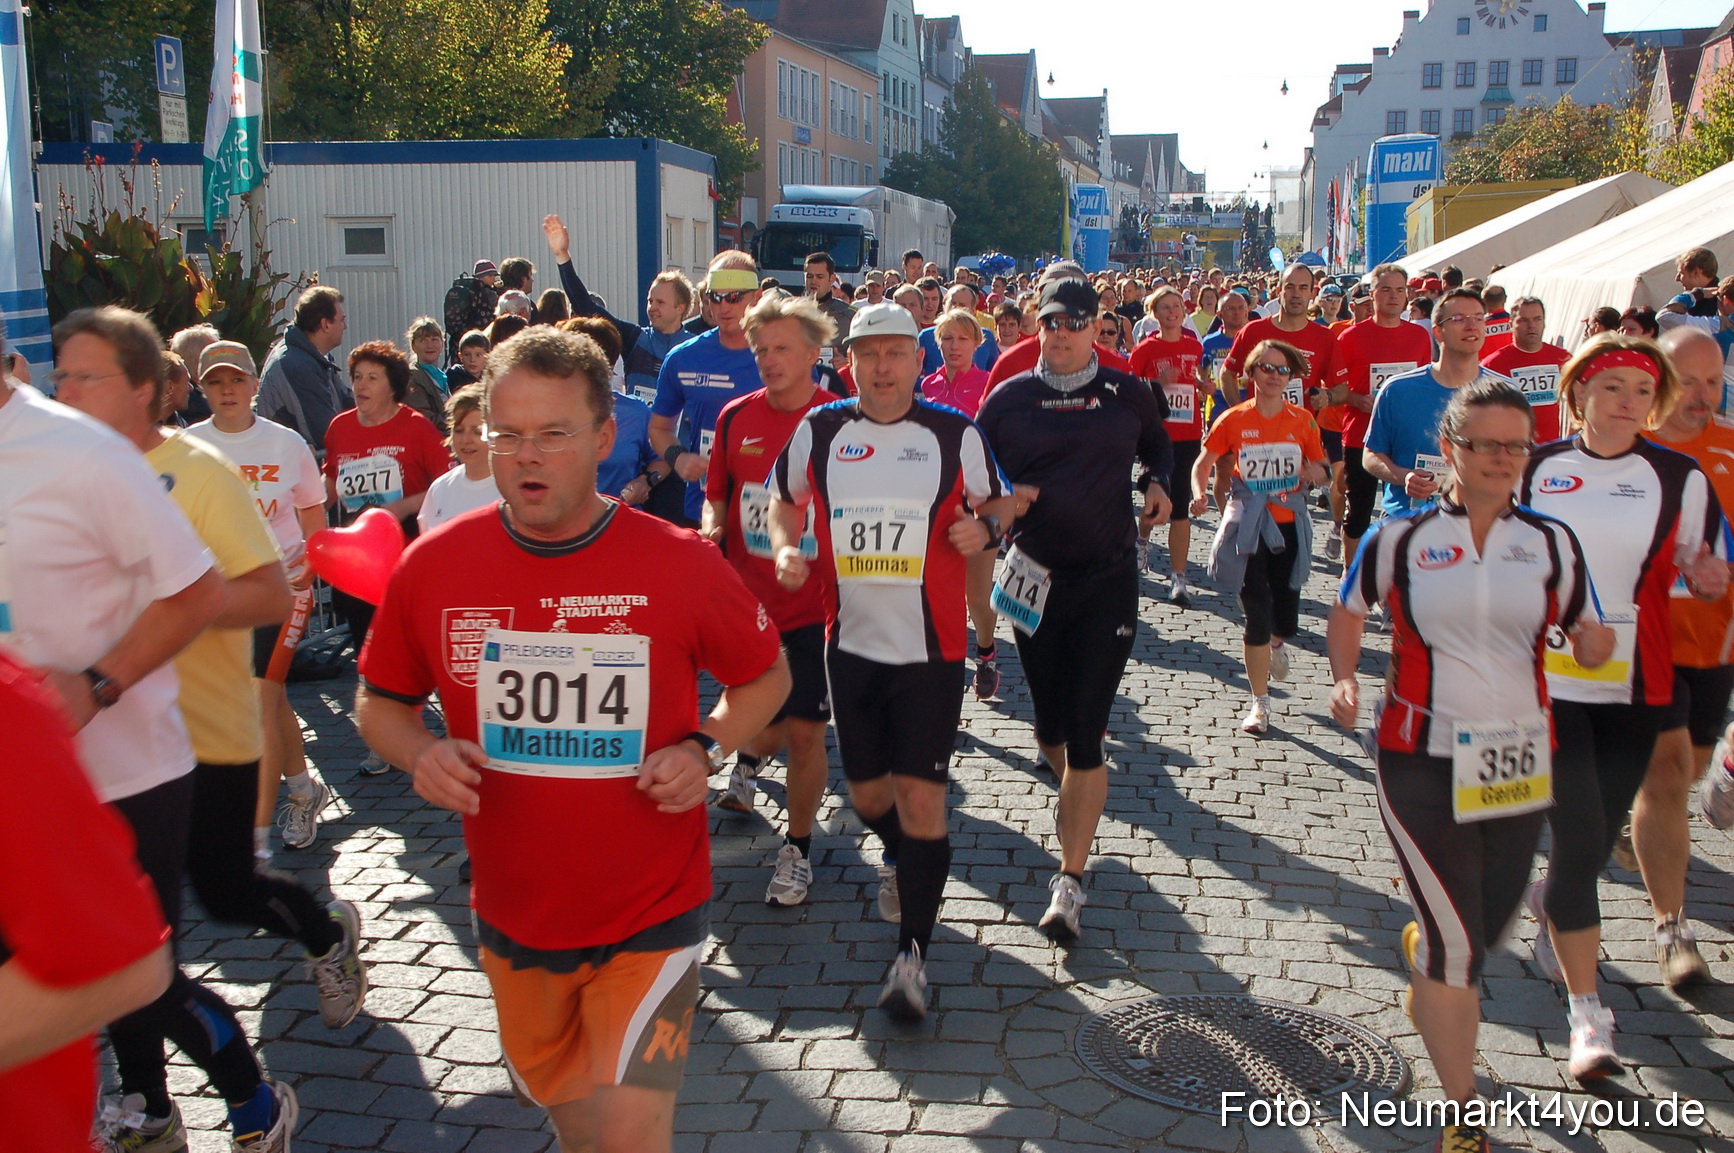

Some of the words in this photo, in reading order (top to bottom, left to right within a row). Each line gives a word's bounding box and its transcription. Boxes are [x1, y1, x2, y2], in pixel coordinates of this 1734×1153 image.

[161, 43, 176, 85] P
[163, 108, 186, 118] Parkschein
[1383, 146, 1434, 174] maxi
[1079, 193, 1101, 210] axi
[790, 207, 838, 217] BOCK
[1085, 216, 1098, 228] dsl
[1519, 375, 1556, 393] 2157
[240, 465, 280, 483] RZ
[1246, 457, 1295, 479] 2715
[343, 470, 391, 496] 3277
[850, 521, 907, 551] 817
[847, 555, 909, 574] Thomas
[539, 597, 559, 608] 11.
[560, 594, 648, 607] NEUMARKTER
[556, 605, 631, 618] STADTLAUF
[451, 619, 501, 630] IMMER
[503, 643, 574, 659] PFLEIDERER
[592, 651, 635, 662] BOCK
[497, 669, 630, 725] 3014
[501, 726, 624, 760] Matthias
[1477, 740, 1535, 784] 356
